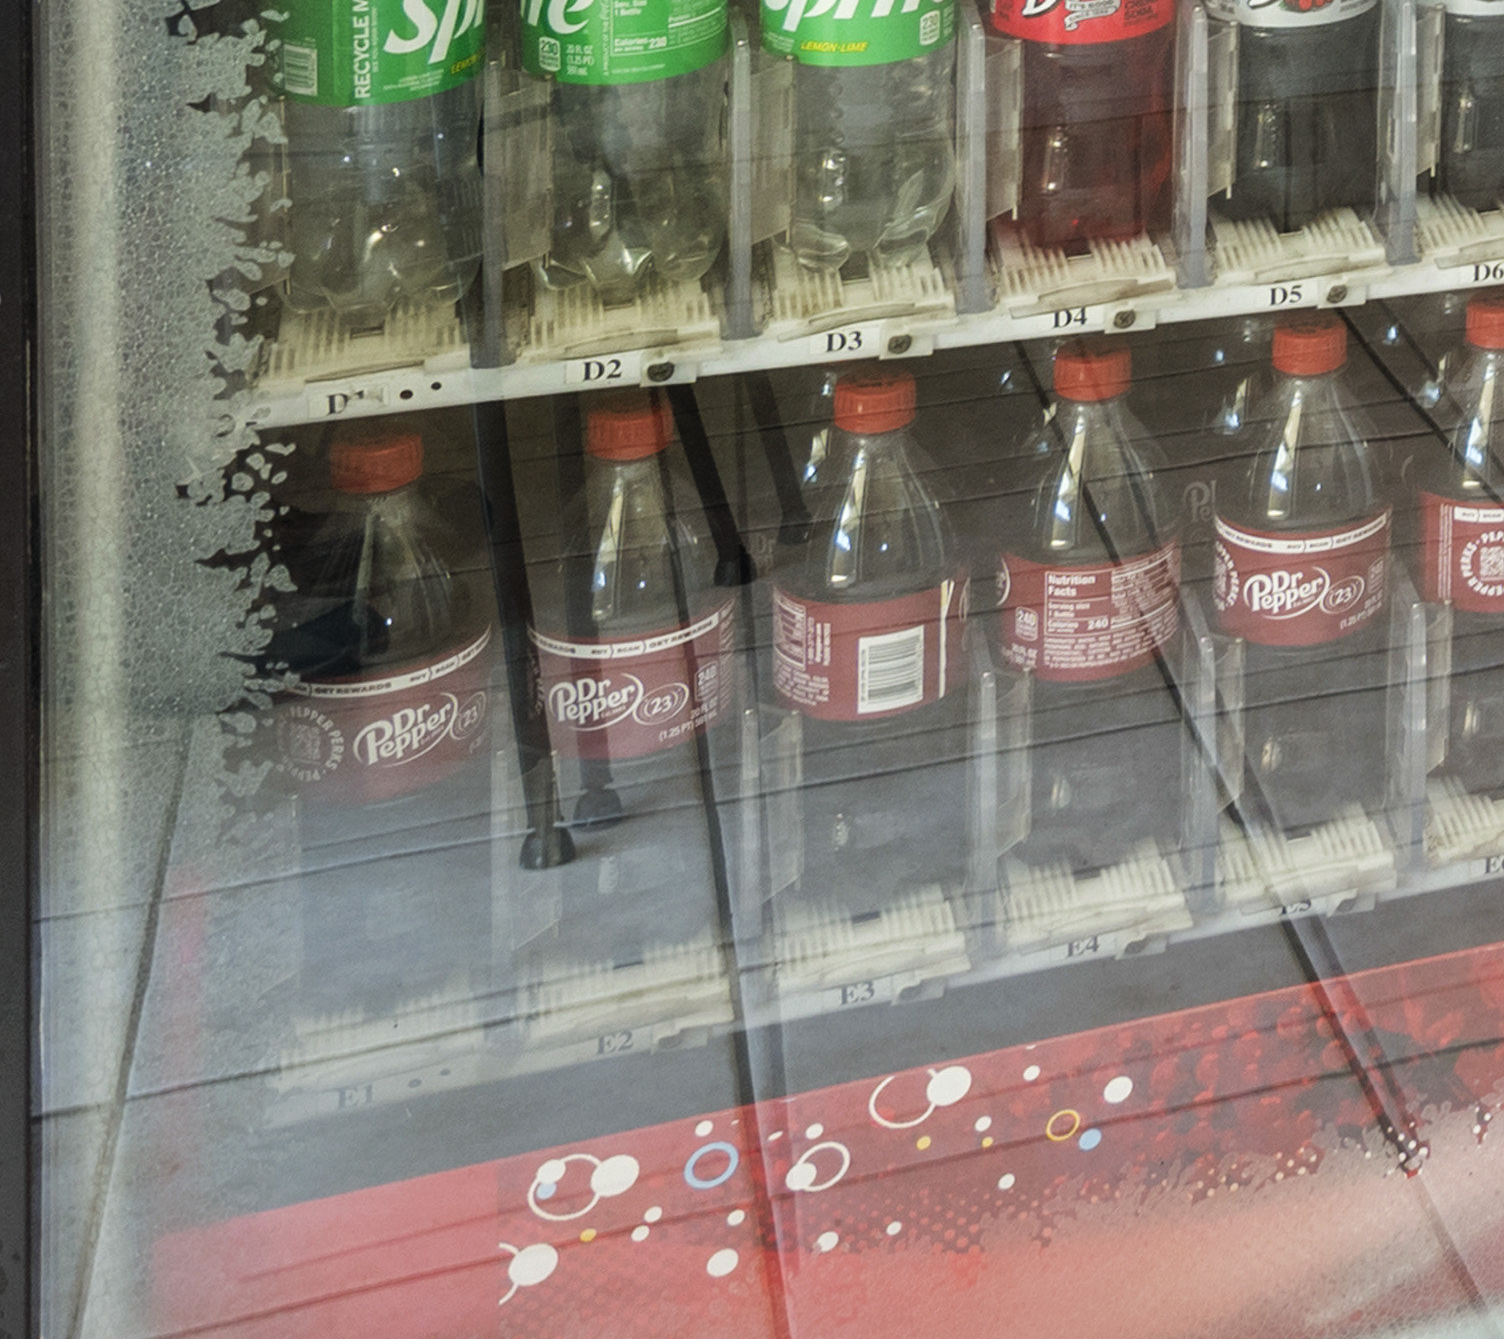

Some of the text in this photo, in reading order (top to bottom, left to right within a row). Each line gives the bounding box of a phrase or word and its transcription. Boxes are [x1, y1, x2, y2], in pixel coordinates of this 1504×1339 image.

[800, 40, 869, 53] LEMON-LIME
[354, 19, 370, 99] RECYCLE
[1268, 284, 1303, 305] D5
[826, 331, 863, 352] D3
[839, 982, 875, 1006] E3
